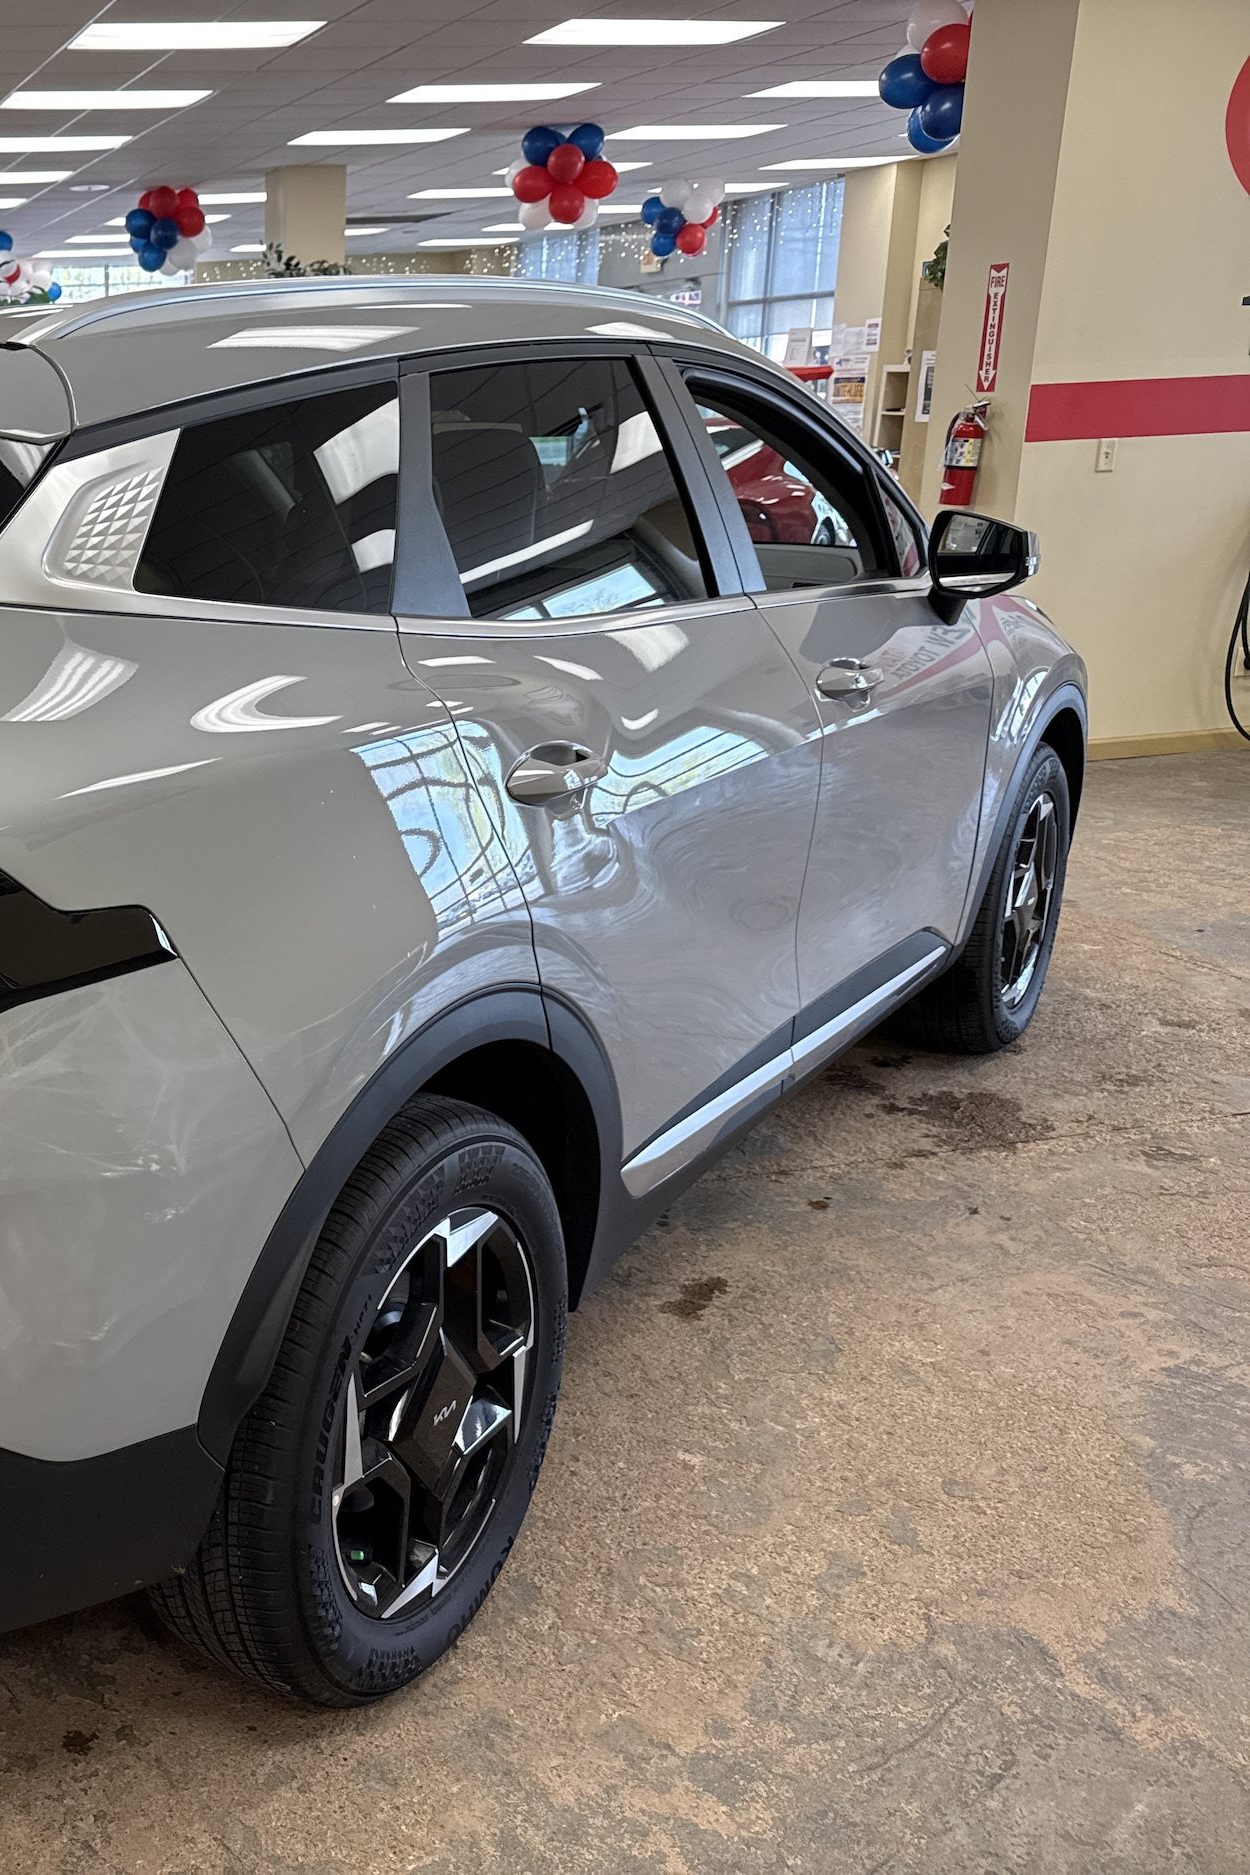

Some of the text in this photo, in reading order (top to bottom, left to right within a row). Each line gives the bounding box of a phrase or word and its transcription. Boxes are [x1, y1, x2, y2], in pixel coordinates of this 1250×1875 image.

[990, 275, 1005, 288] FIRE
[983, 292, 999, 382] EXTINGUISHER
[433, 1399, 457, 1426] KIA
